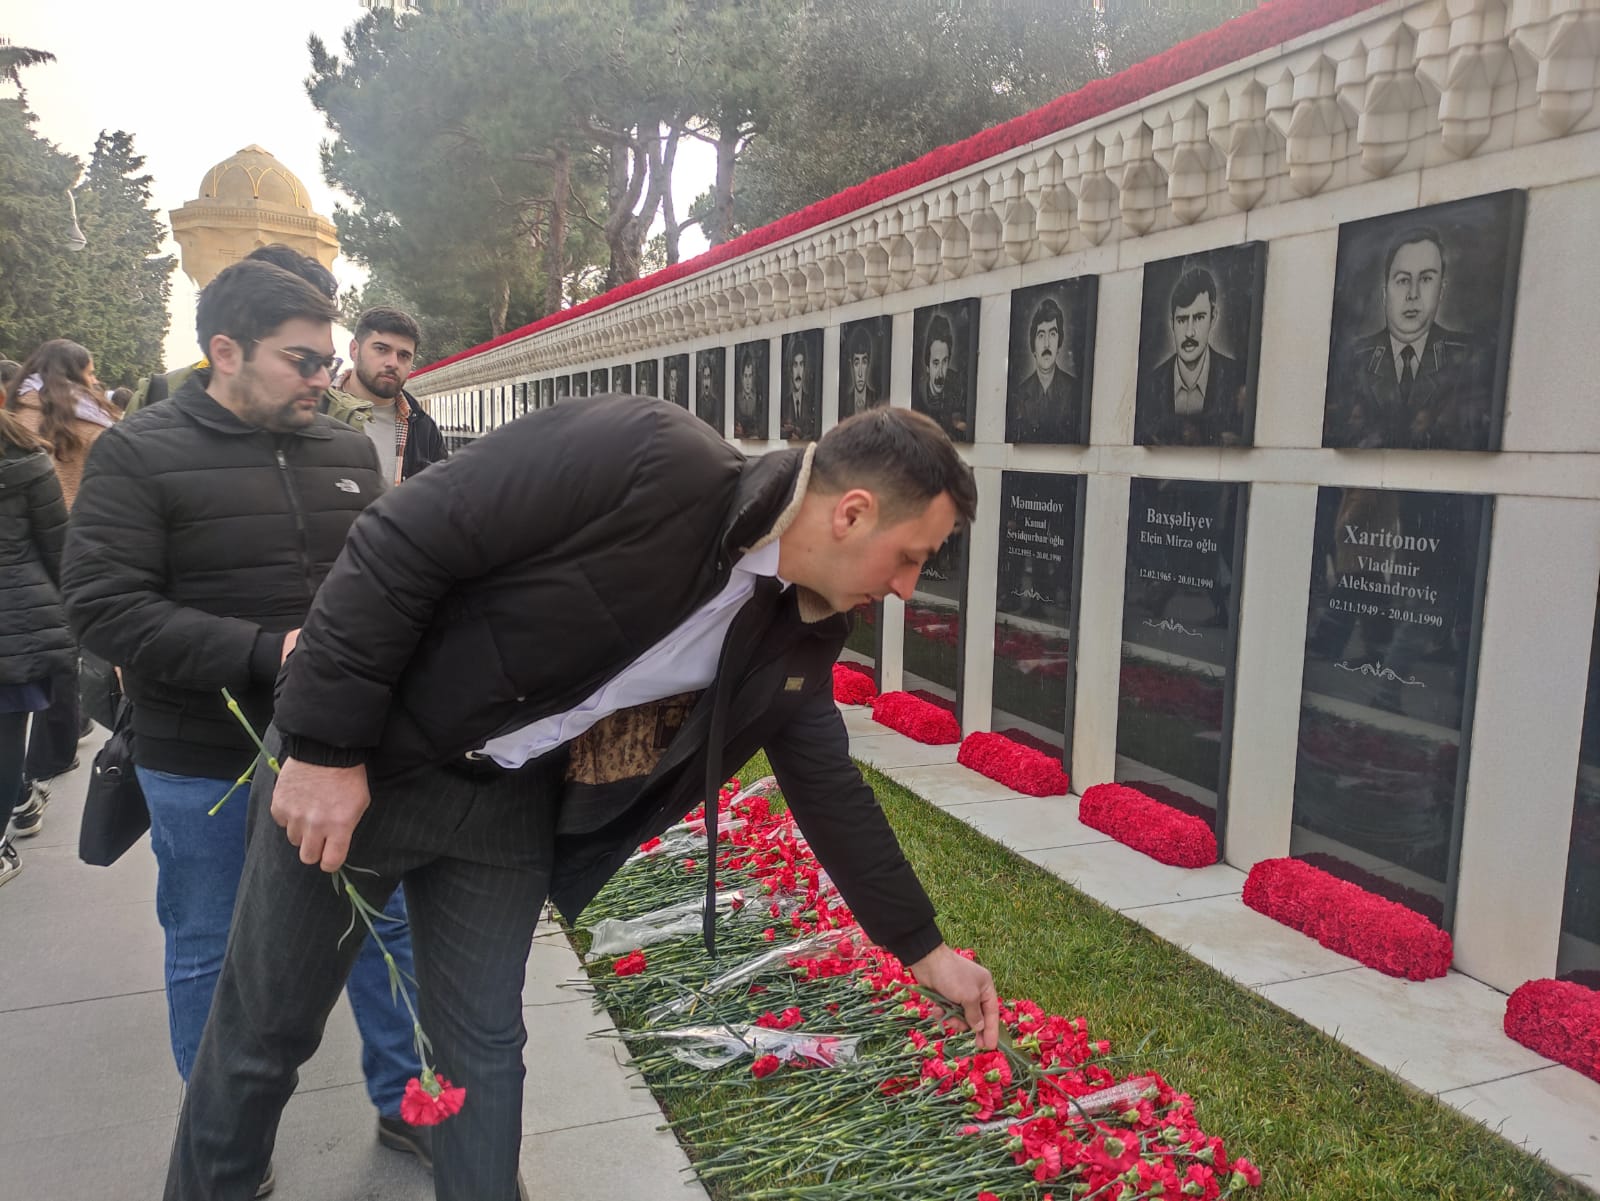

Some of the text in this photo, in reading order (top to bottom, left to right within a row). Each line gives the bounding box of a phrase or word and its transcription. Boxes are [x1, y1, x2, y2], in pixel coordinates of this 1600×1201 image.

[1011, 496, 1064, 513] Məmmədov
[1147, 508, 1213, 531] Baxşəliyev
[1140, 531, 1217, 553] Elçin Mirzə oğlu
[1344, 525, 1440, 552] Xaritonov
[1357, 555, 1420, 577] Vladimir
[1178, 575, 1214, 589] 20.01.1990
[1338, 574, 1438, 604] Aleksandroviç
[1329, 598, 1378, 616] 02.11.1949
[1388, 608, 1443, 627] 20.01.1990
